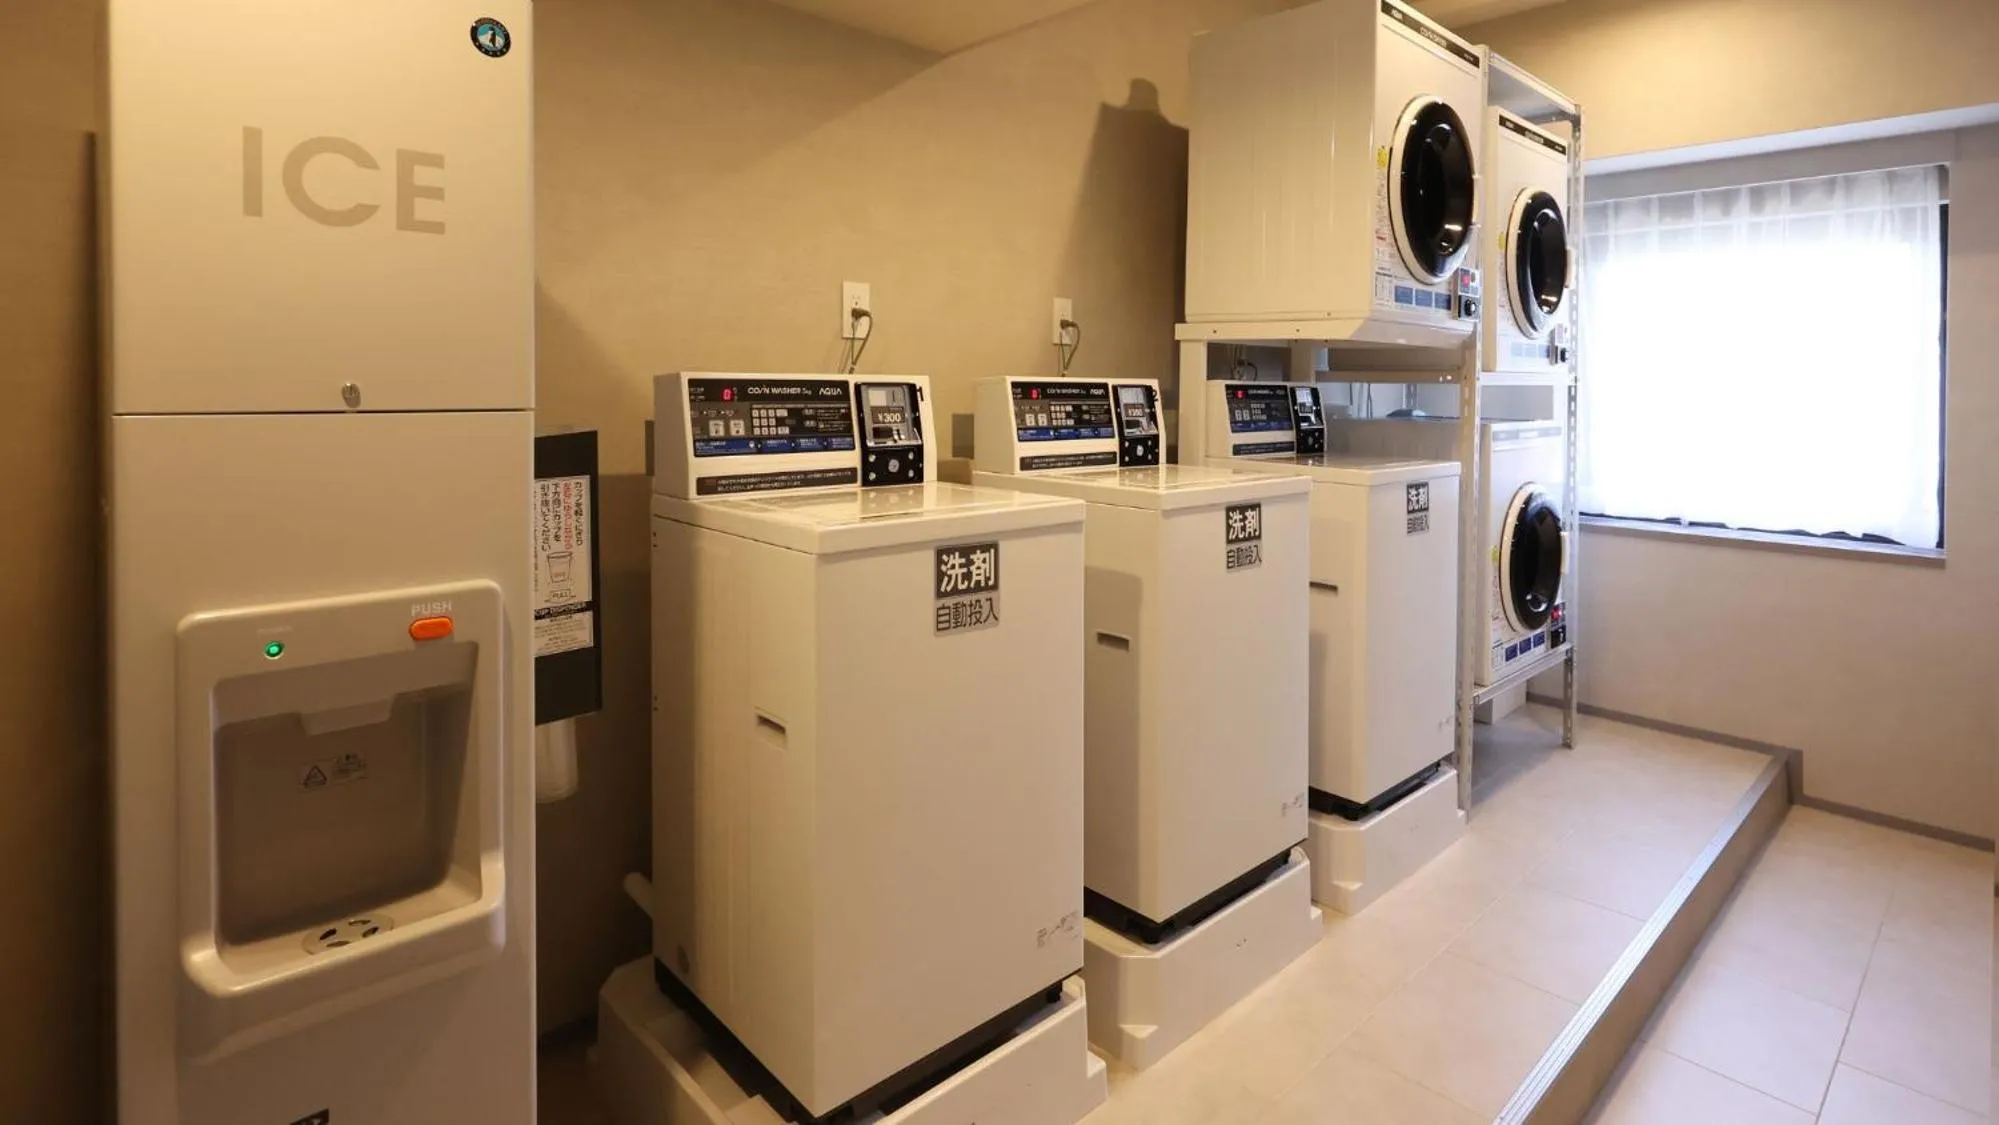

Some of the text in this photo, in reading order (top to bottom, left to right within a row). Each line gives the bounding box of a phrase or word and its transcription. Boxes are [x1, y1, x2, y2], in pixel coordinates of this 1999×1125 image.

[242, 125, 445, 235] ICE
[771, 387, 801, 395] WASHER
[819, 387, 842, 396] AQUA
[877, 412, 902, 422] ¥300
[1228, 507, 1260, 539] 洗剤
[940, 548, 995, 592] 洗剤
[1226, 544, 1262, 569] 自動投入
[411, 601, 452, 616] PUSH
[936, 597, 999, 632] 自動投入
